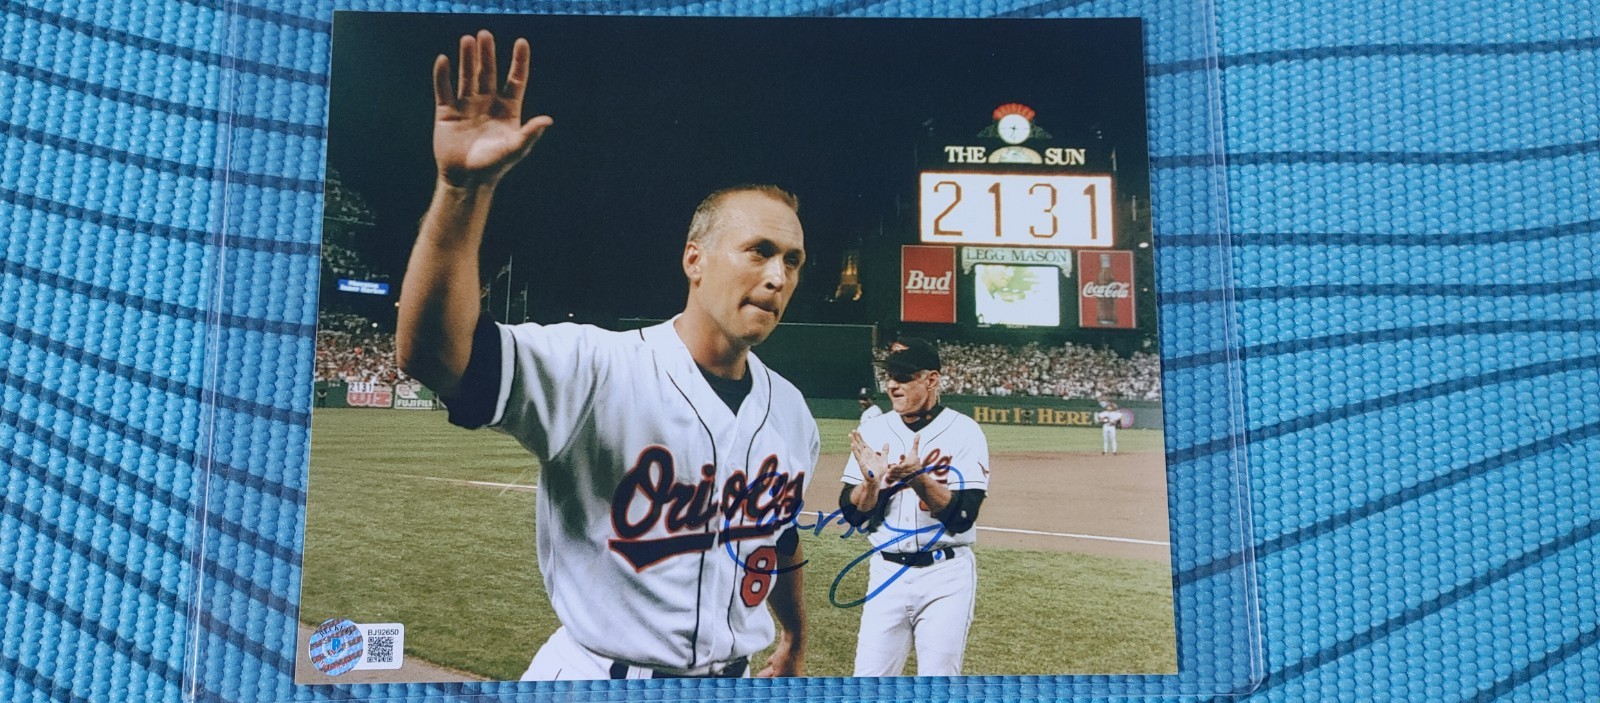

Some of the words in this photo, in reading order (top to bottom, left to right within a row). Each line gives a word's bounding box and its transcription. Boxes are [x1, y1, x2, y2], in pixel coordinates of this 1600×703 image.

[944, 145, 987, 163] THE
[1044, 147, 1086, 165] SUN
[933, 180, 1098, 240] 2131
[966, 248, 1005, 261] LEGG
[1011, 250, 1068, 263] MASON
[905, 269, 953, 291] Bud
[349, 383, 373, 392] 2131
[740, 545, 778, 608] 8
[367, 628, 400, 636] BJ92650
